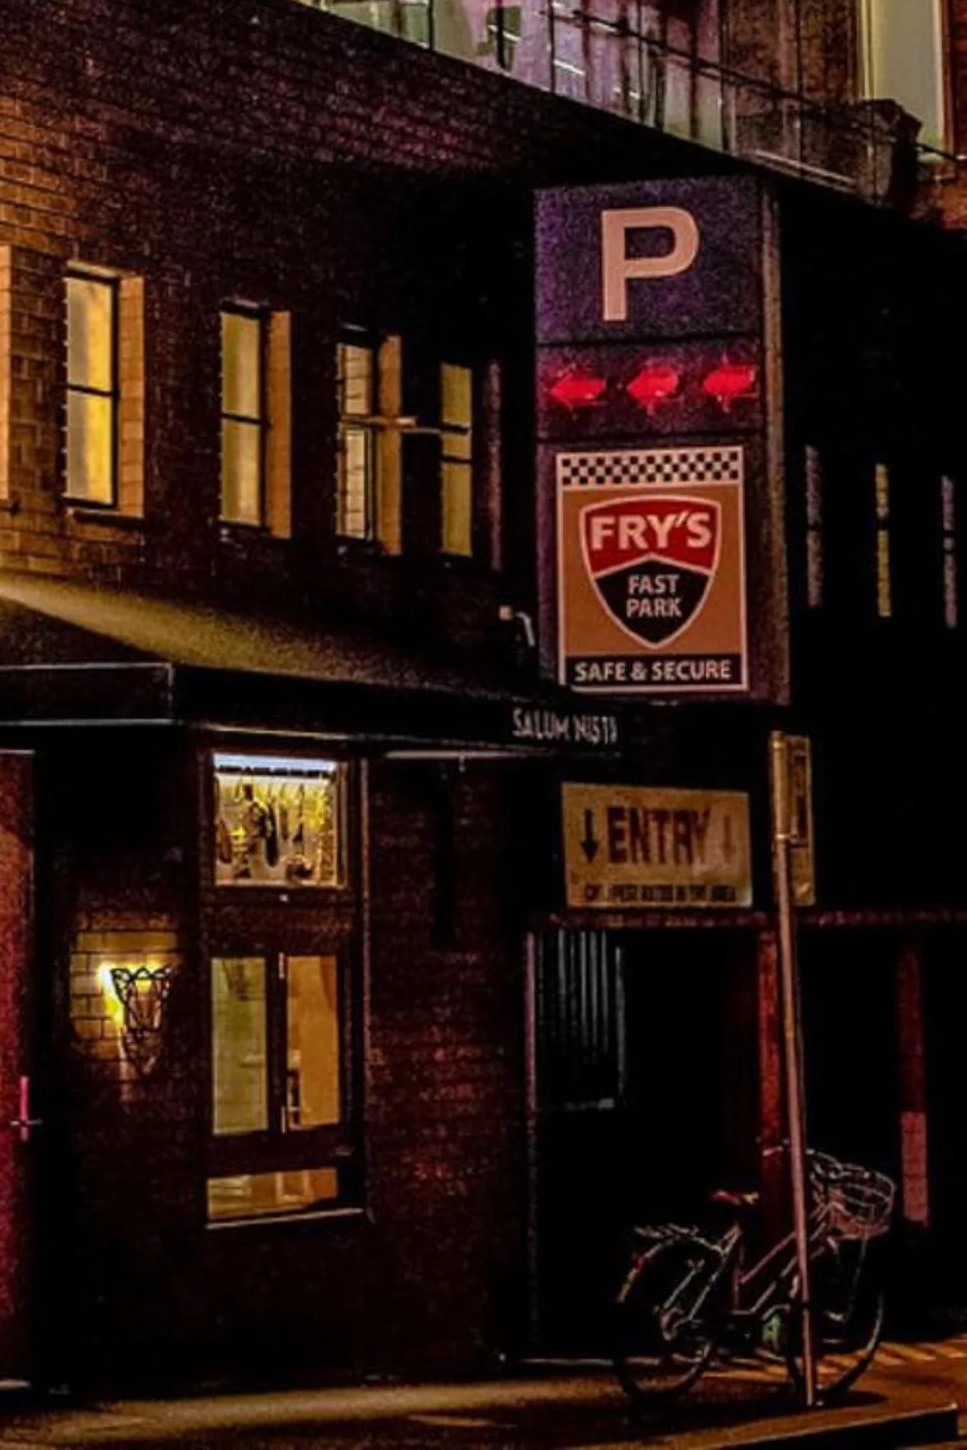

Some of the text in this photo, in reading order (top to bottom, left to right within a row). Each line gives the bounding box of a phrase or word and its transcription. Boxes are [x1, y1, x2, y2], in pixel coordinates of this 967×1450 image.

[601, 205, 700, 322] P
[590, 509, 713, 551] FRY'S
[628, 573, 680, 596] FAST
[626, 595, 683, 619] PARK
[574, 662, 626, 684] SAFE
[650, 659, 732, 682] SECURE
[605, 806, 711, 866] ENTRY
